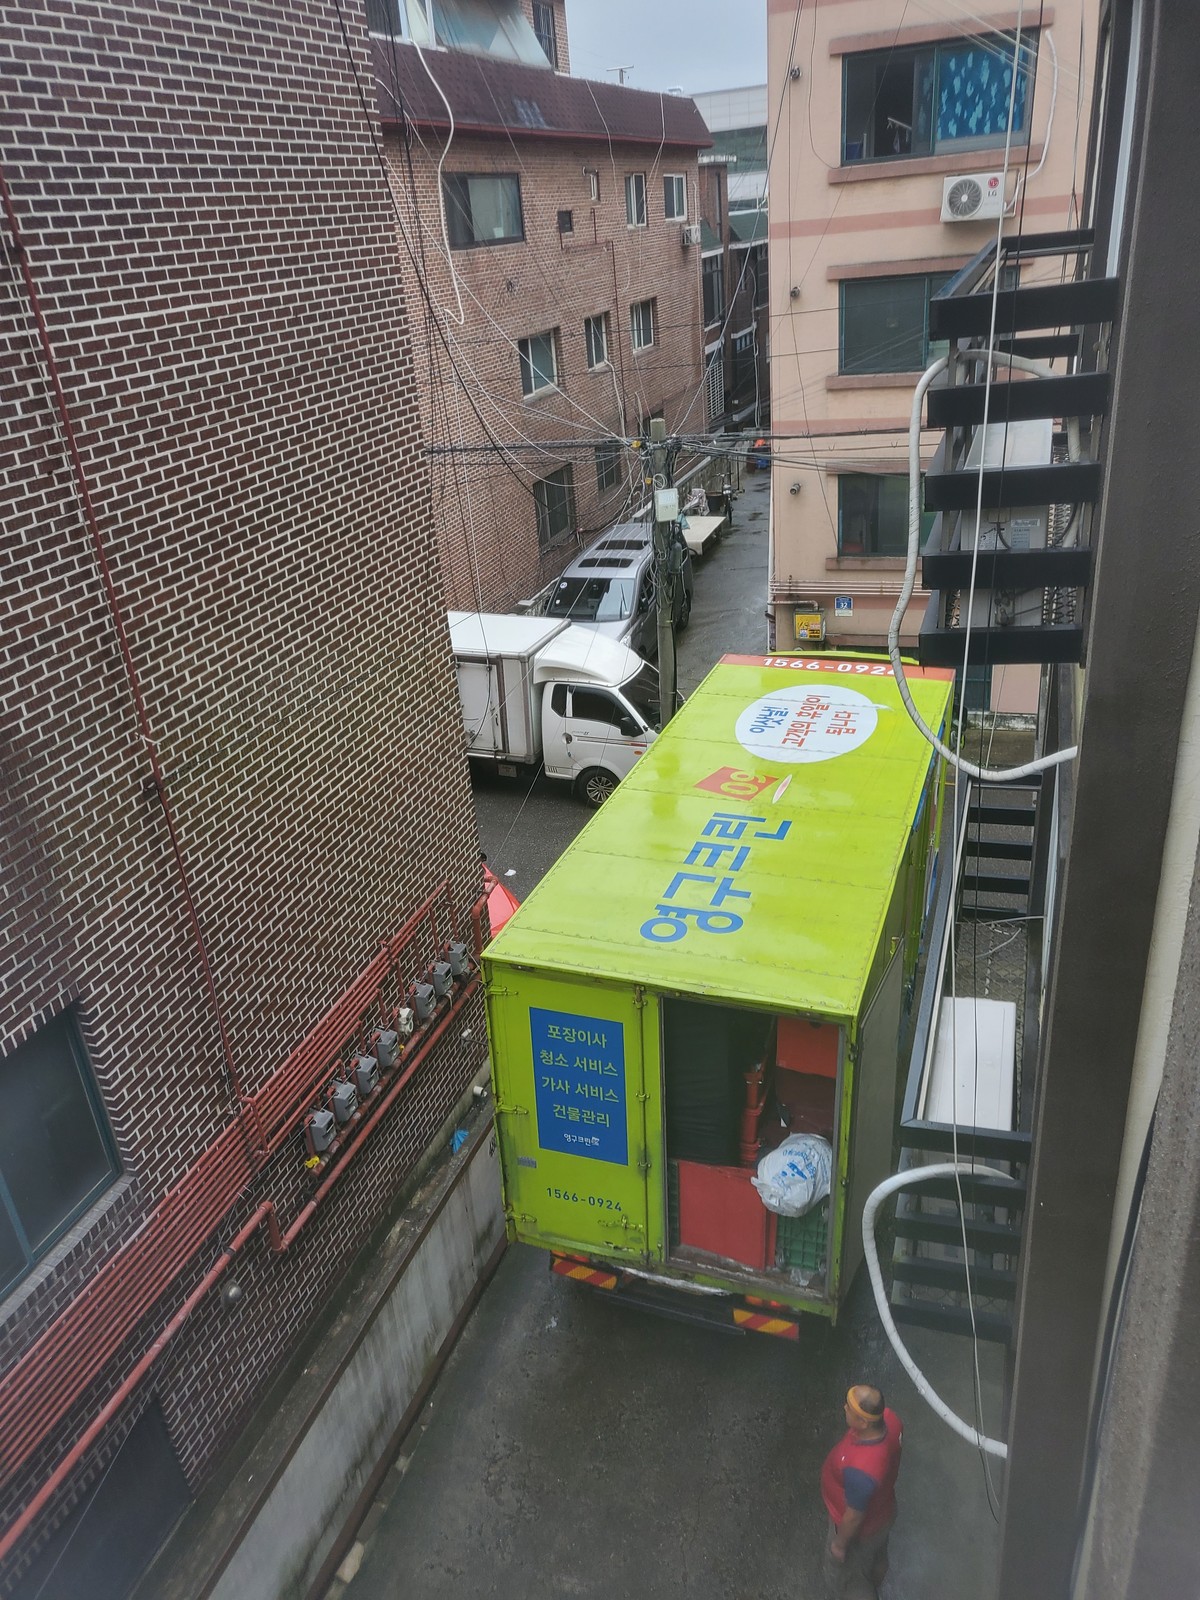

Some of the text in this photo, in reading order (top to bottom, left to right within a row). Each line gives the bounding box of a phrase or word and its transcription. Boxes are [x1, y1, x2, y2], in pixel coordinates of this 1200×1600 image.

[749, 706, 789, 734] 이삿날!
[781, 694, 831, 748] 고객의 휴일이
[825, 710, 860, 736] 됩니다
[639, 812, 793, 943] 영구크린
[547, 1024, 608, 1049] 포장이사
[539, 1049, 619, 1077] 청소 서비스
[541, 1076, 620, 1103] 가사 서비스
[552, 1103, 611, 1128] 건물관리
[546, 1187, 623, 1212] 1566-0924
